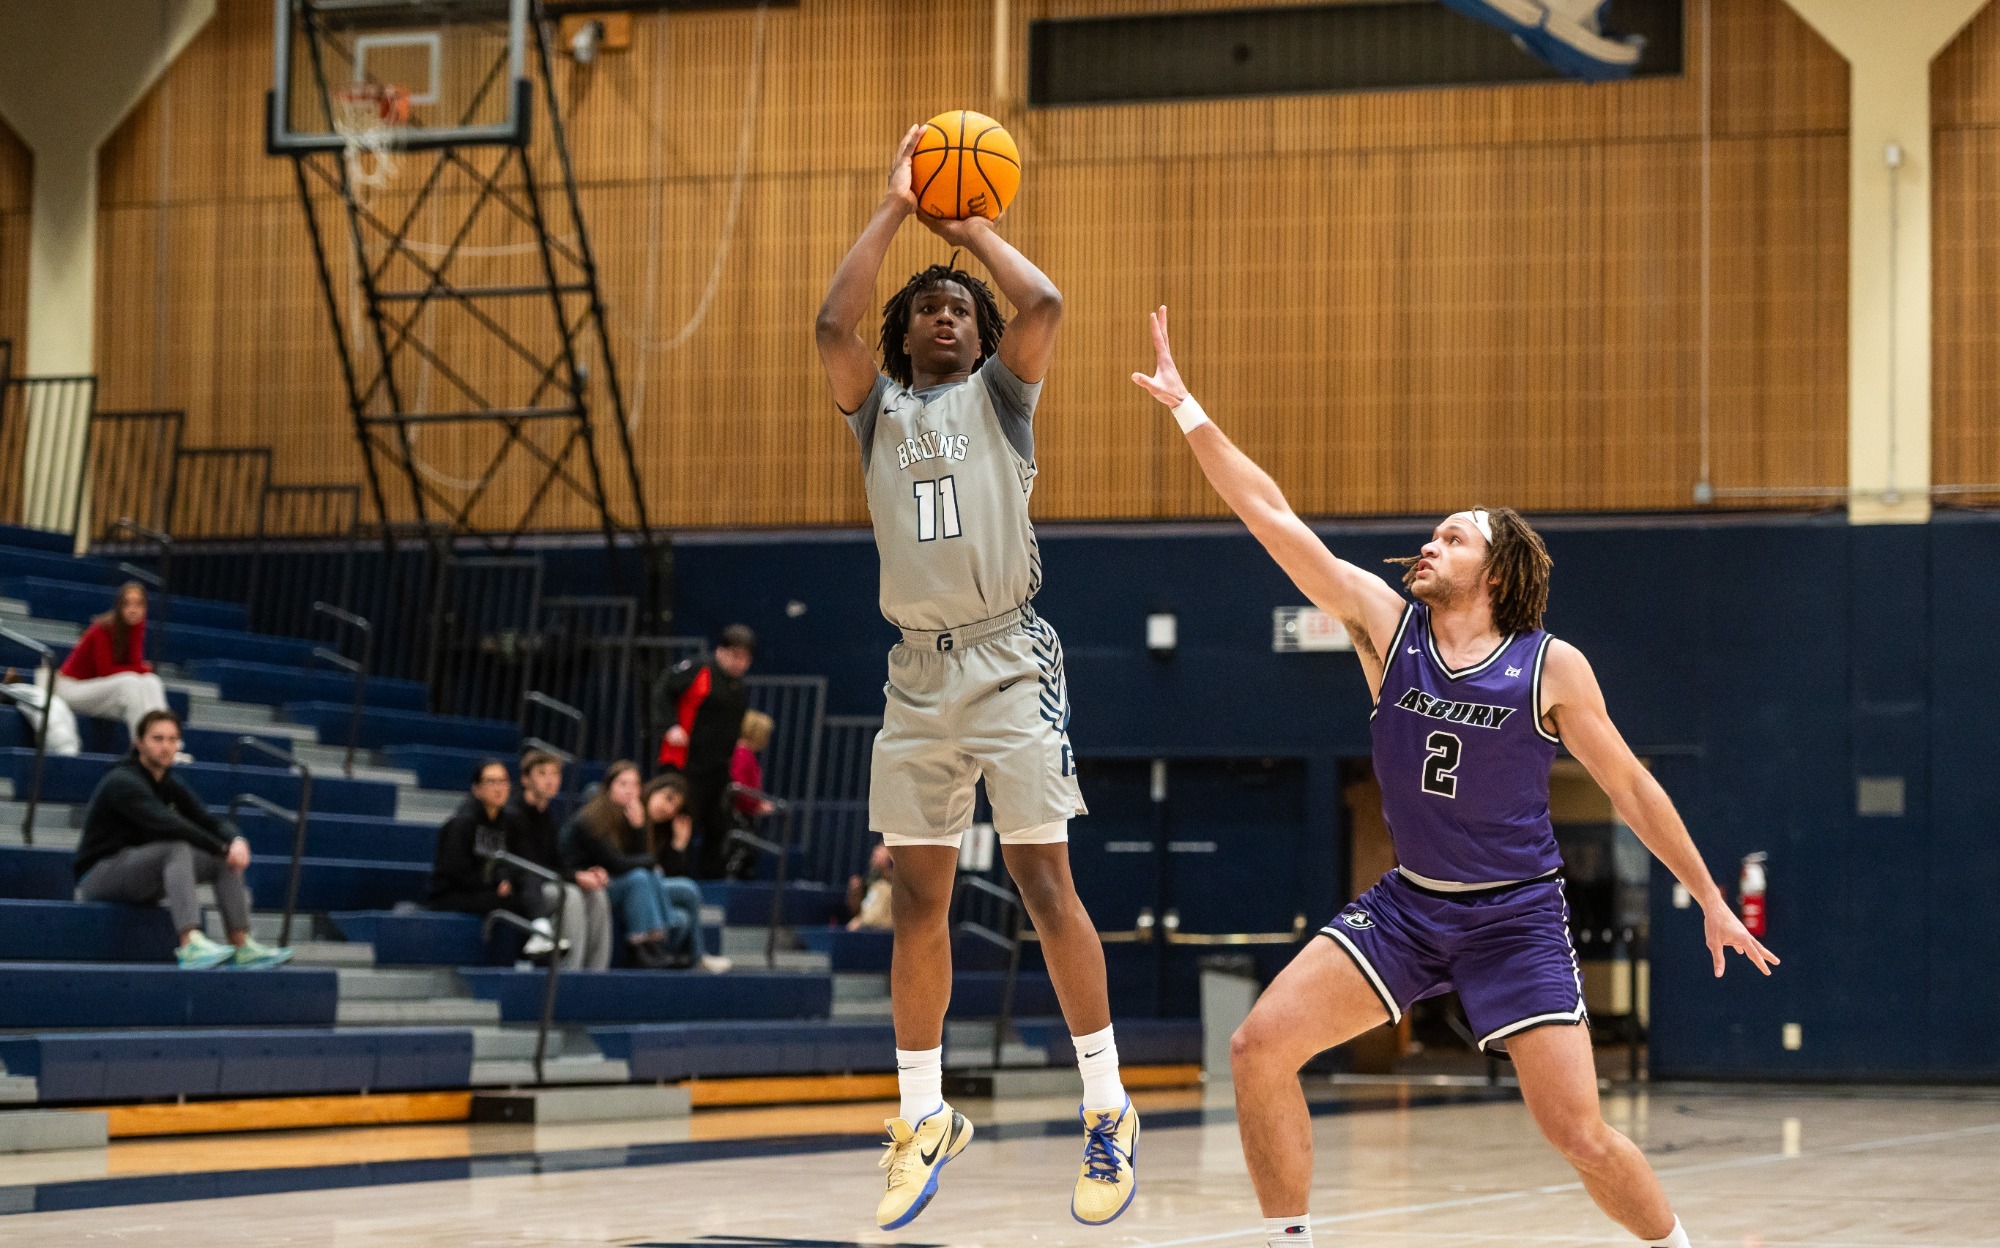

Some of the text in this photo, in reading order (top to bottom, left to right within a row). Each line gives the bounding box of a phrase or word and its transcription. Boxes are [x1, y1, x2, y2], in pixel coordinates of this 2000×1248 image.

[913, 474, 962, 543] 11
[936, 632, 954, 651] G
[1394, 687, 1518, 730] ASBURY
[1421, 730, 1463, 799] 2
